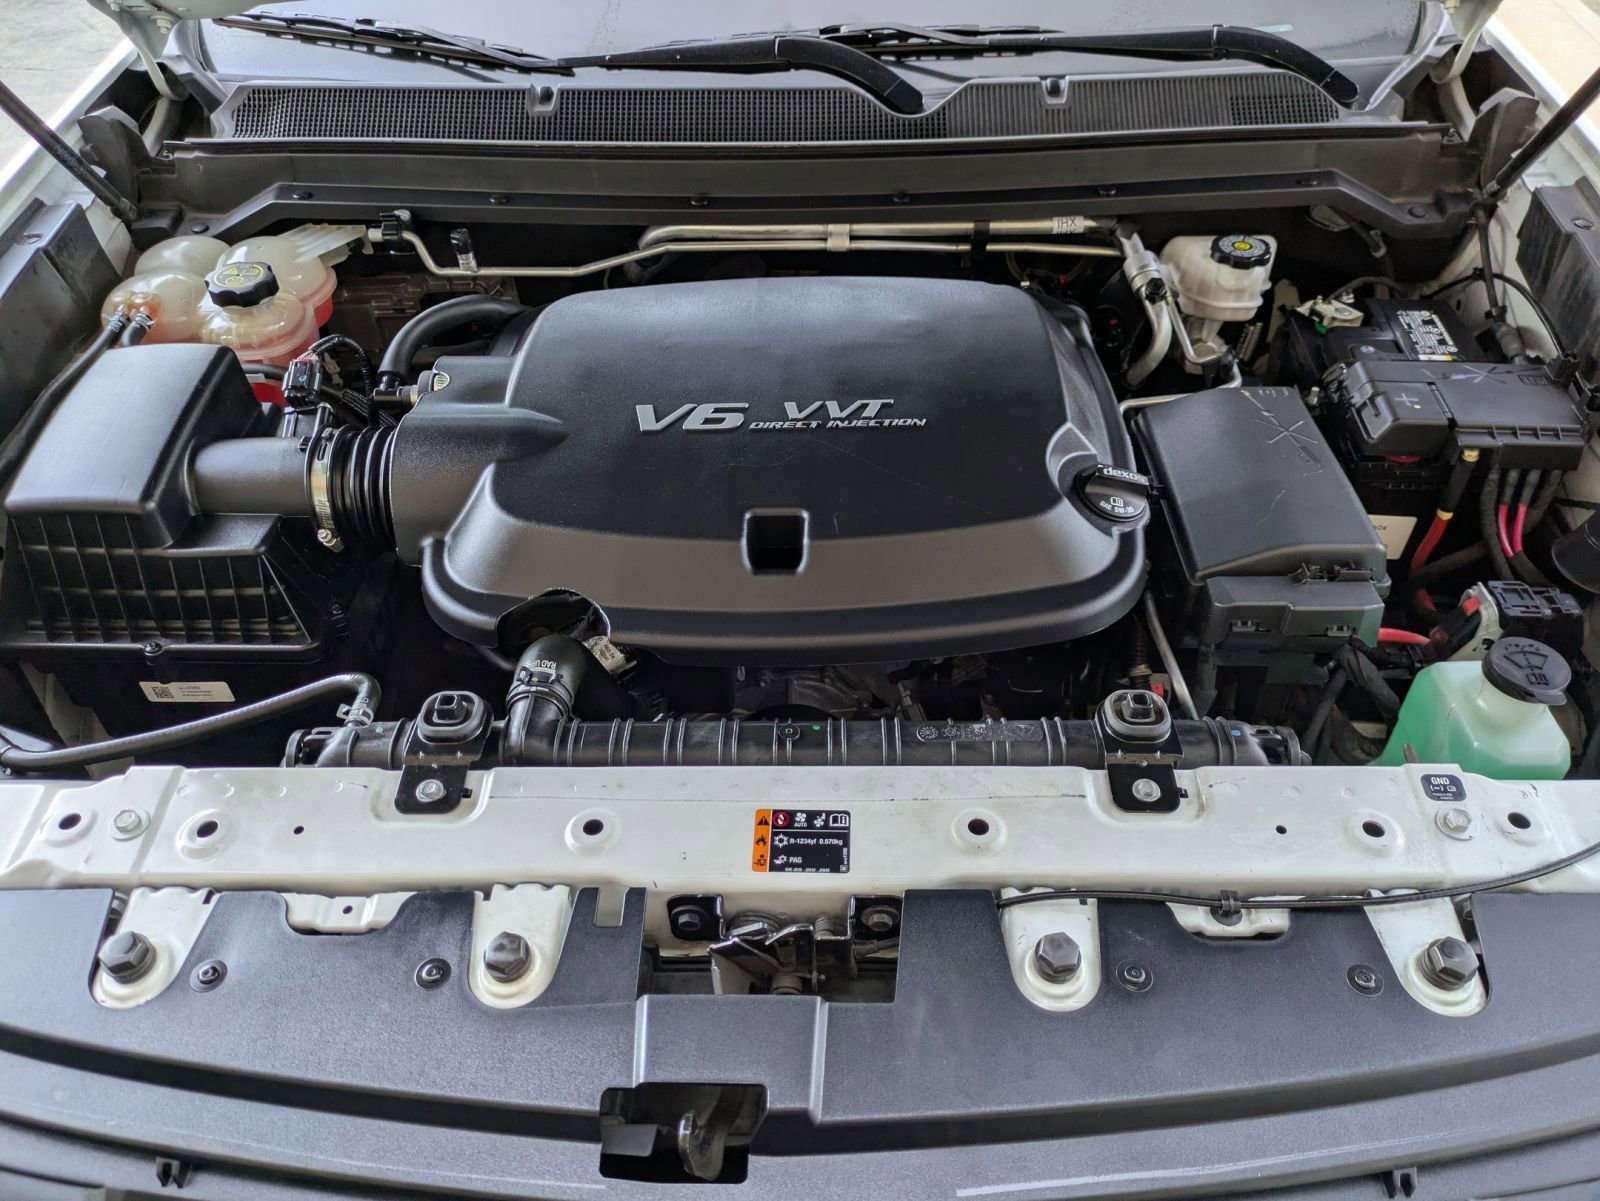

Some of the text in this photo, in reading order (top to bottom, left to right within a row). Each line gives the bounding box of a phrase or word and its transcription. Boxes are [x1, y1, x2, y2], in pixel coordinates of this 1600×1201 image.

[636, 399, 894, 432] V6 VVT
[748, 418, 927, 431] DIRECT INJECTION
[1430, 776, 1450, 785] GND
[789, 838, 817, 846] R-1234yf
[789, 856, 802, 864] PAG
